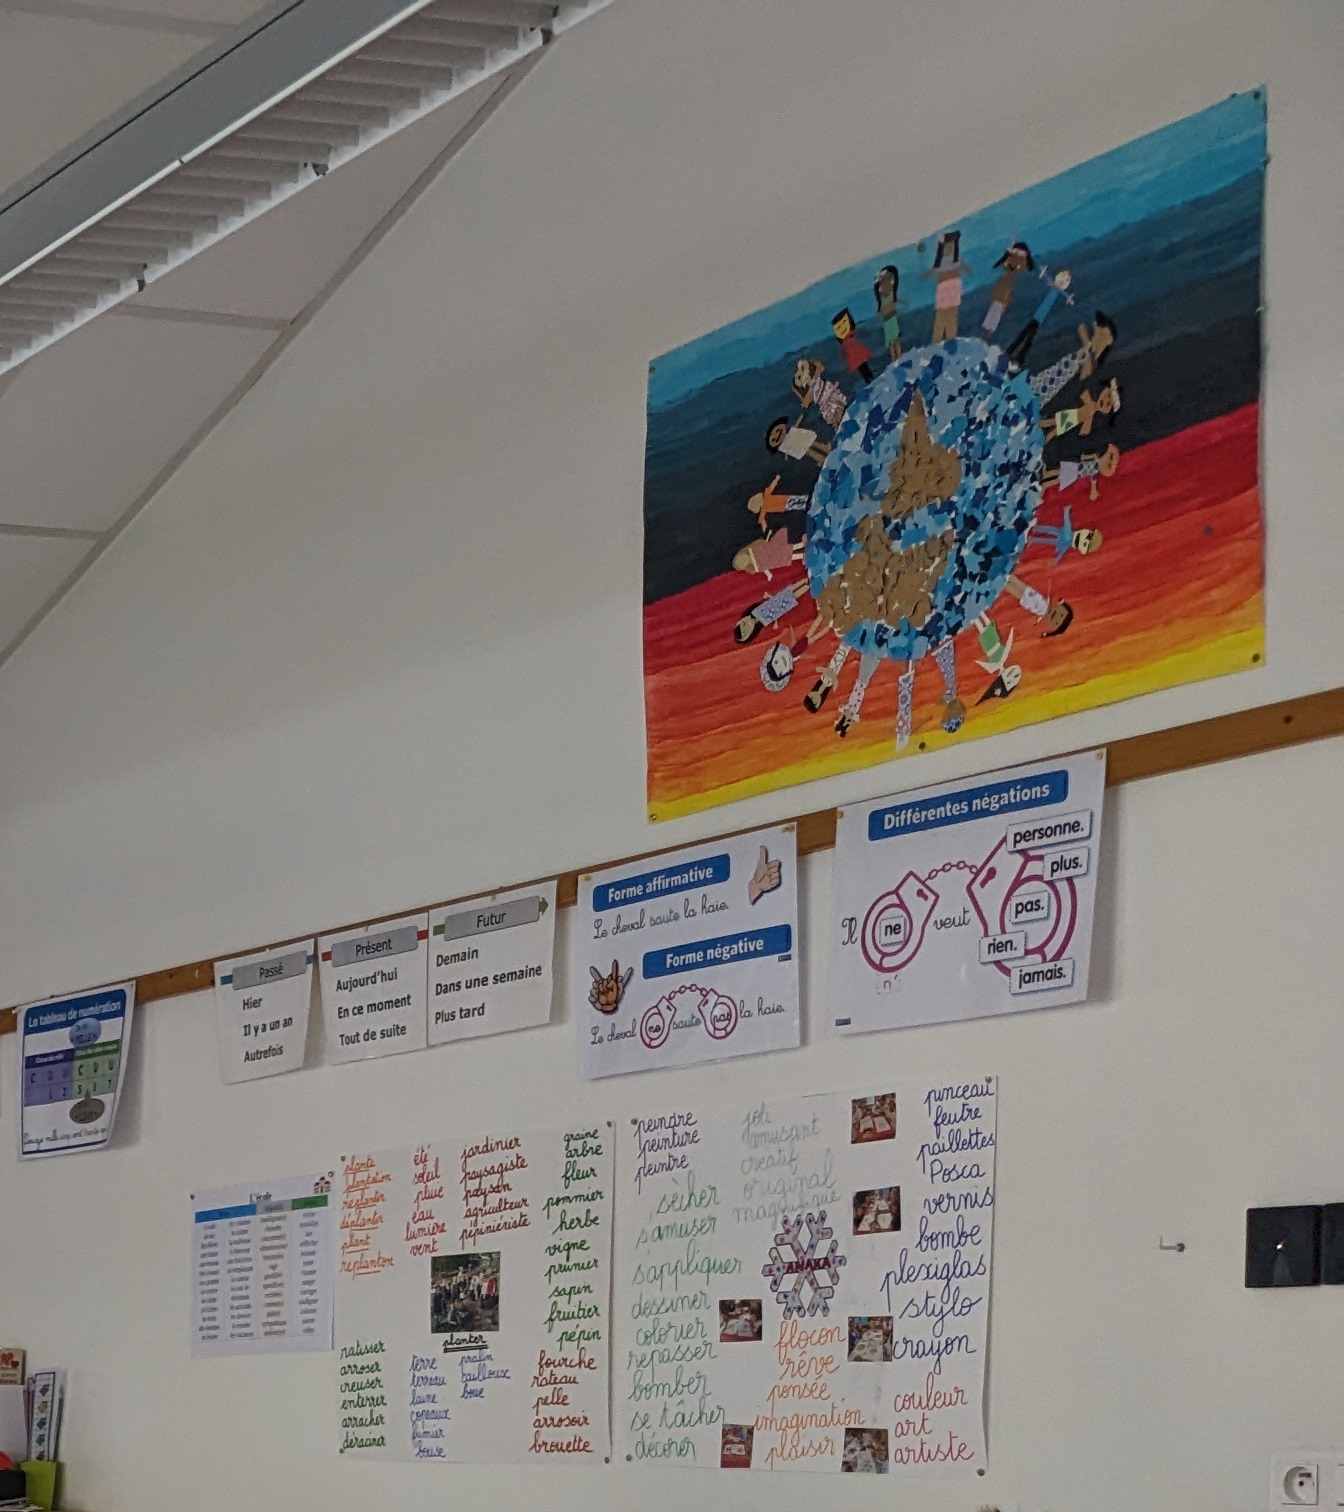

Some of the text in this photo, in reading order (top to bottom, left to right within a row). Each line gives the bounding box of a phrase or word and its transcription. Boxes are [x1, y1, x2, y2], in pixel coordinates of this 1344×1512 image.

[883, 783, 1050, 831] Différentes négations
[1013, 820, 1084, 848] personne.
[1050, 854, 1083, 878] plus.
[608, 865, 713, 903] Forme affirmative
[476, 912, 507, 928] Futur
[593, 919, 608, 940] Le
[612, 908, 646, 936] cheval
[683, 898, 697, 919] la
[884, 922, 901, 935] ne
[932, 907, 971, 931] veut
[1014, 898, 1044, 919] pas.
[355, 938, 393, 957] Présent
[436, 947, 479, 968] Demain
[666, 937, 764, 969] Forme négative
[987, 937, 1017, 955] rien.
[259, 962, 284, 979] Passé
[335, 967, 398, 993] Aujourd'hui
[435, 964, 543, 996] Dans une semaine
[1018, 964, 1067, 990] jamais.
[242, 997, 263, 1010] Hier
[337, 994, 412, 1019] En ce moment
[434, 1002, 486, 1025] Plus tard
[242, 1017, 293, 1037] Il y a un an
[339, 1023, 407, 1047] Tout de suite
[243, 1044, 284, 1063] Autrefois
[924, 1083, 995, 1117] pinceau
[934, 1102, 982, 1139] feutre
[565, 1143, 604, 1158] arbre
[916, 1127, 996, 1174] paillettes
[561, 1161, 598, 1189] fleur
[930, 1158, 987, 1184] Posca
[923, 1185, 995, 1214] vernis
[552, 1210, 600, 1234] herbe
[915, 1214, 982, 1252] bombe
[544, 1238, 591, 1262] vigne
[879, 1248, 987, 1313] plexiglas
[543, 1301, 601, 1333] fruitier
[899, 1286, 983, 1338] stylo
[442, 1333, 487, 1347] planter
[773, 1319, 847, 1365] flocon
[339, 1362, 382, 1376] arroser
[537, 1347, 598, 1376] fourche
[779, 1351, 840, 1381] rêve
[892, 1334, 977, 1376] crayon
[628, 1364, 712, 1401] bomber
[893, 1372, 968, 1413] couleur
[340, 1393, 387, 1410] enterrer
[532, 1387, 570, 1415] pelle
[532, 1410, 591, 1429] arrosoir
[753, 1398, 865, 1446] imagination
[894, 1412, 933, 1438] art
[529, 1430, 593, 1454] brouette
[765, 1429, 835, 1471] plaisir
[894, 1430, 974, 1465] artiste
